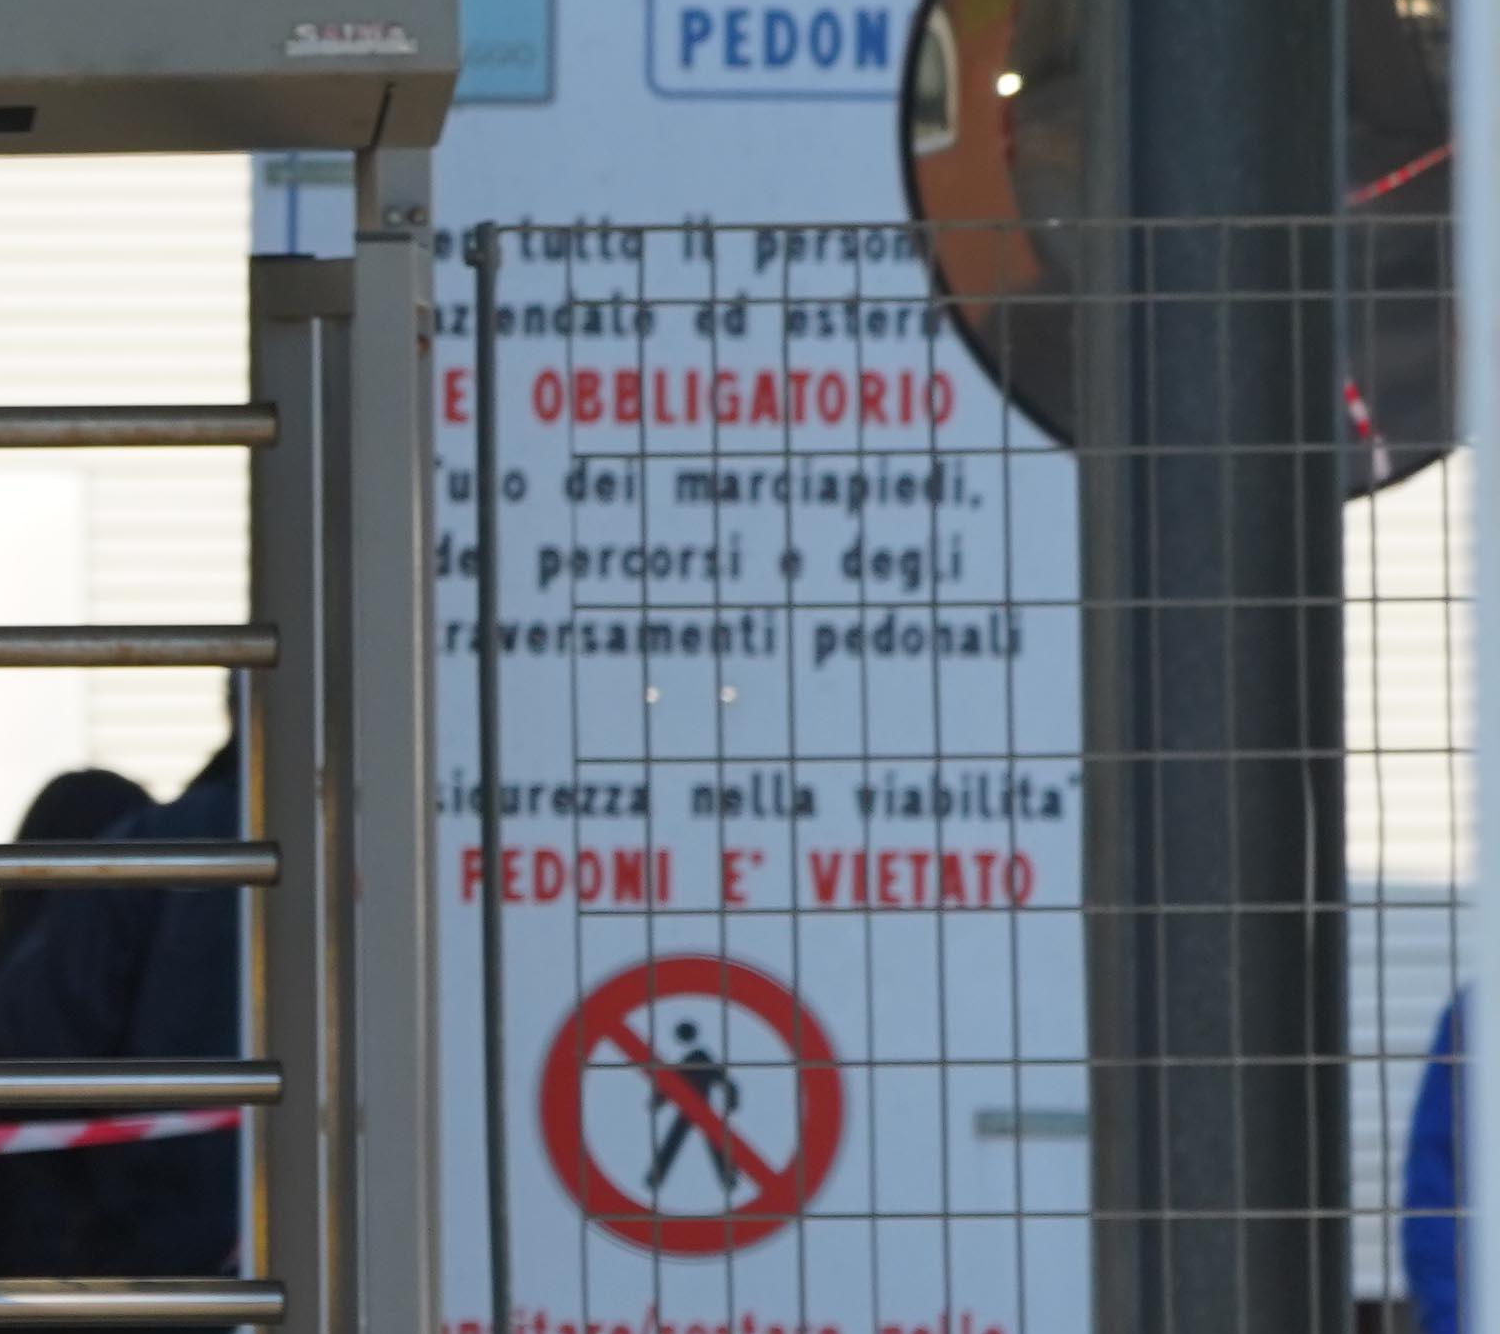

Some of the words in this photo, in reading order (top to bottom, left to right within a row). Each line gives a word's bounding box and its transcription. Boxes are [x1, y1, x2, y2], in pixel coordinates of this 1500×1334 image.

[680, 7, 892, 70] PEDON
[753, 225, 916, 272] person
[532, 371, 953, 424] OBBLIGATORIO
[565, 457, 638, 503] dei
[538, 533, 741, 593] percorsi
[842, 533, 963, 591] degi
[813, 611, 1021, 668] pedonali
[691, 768, 813, 819] nella
[461, 848, 670, 903] PEDONI
[808, 851, 1035, 905] VIETATO
